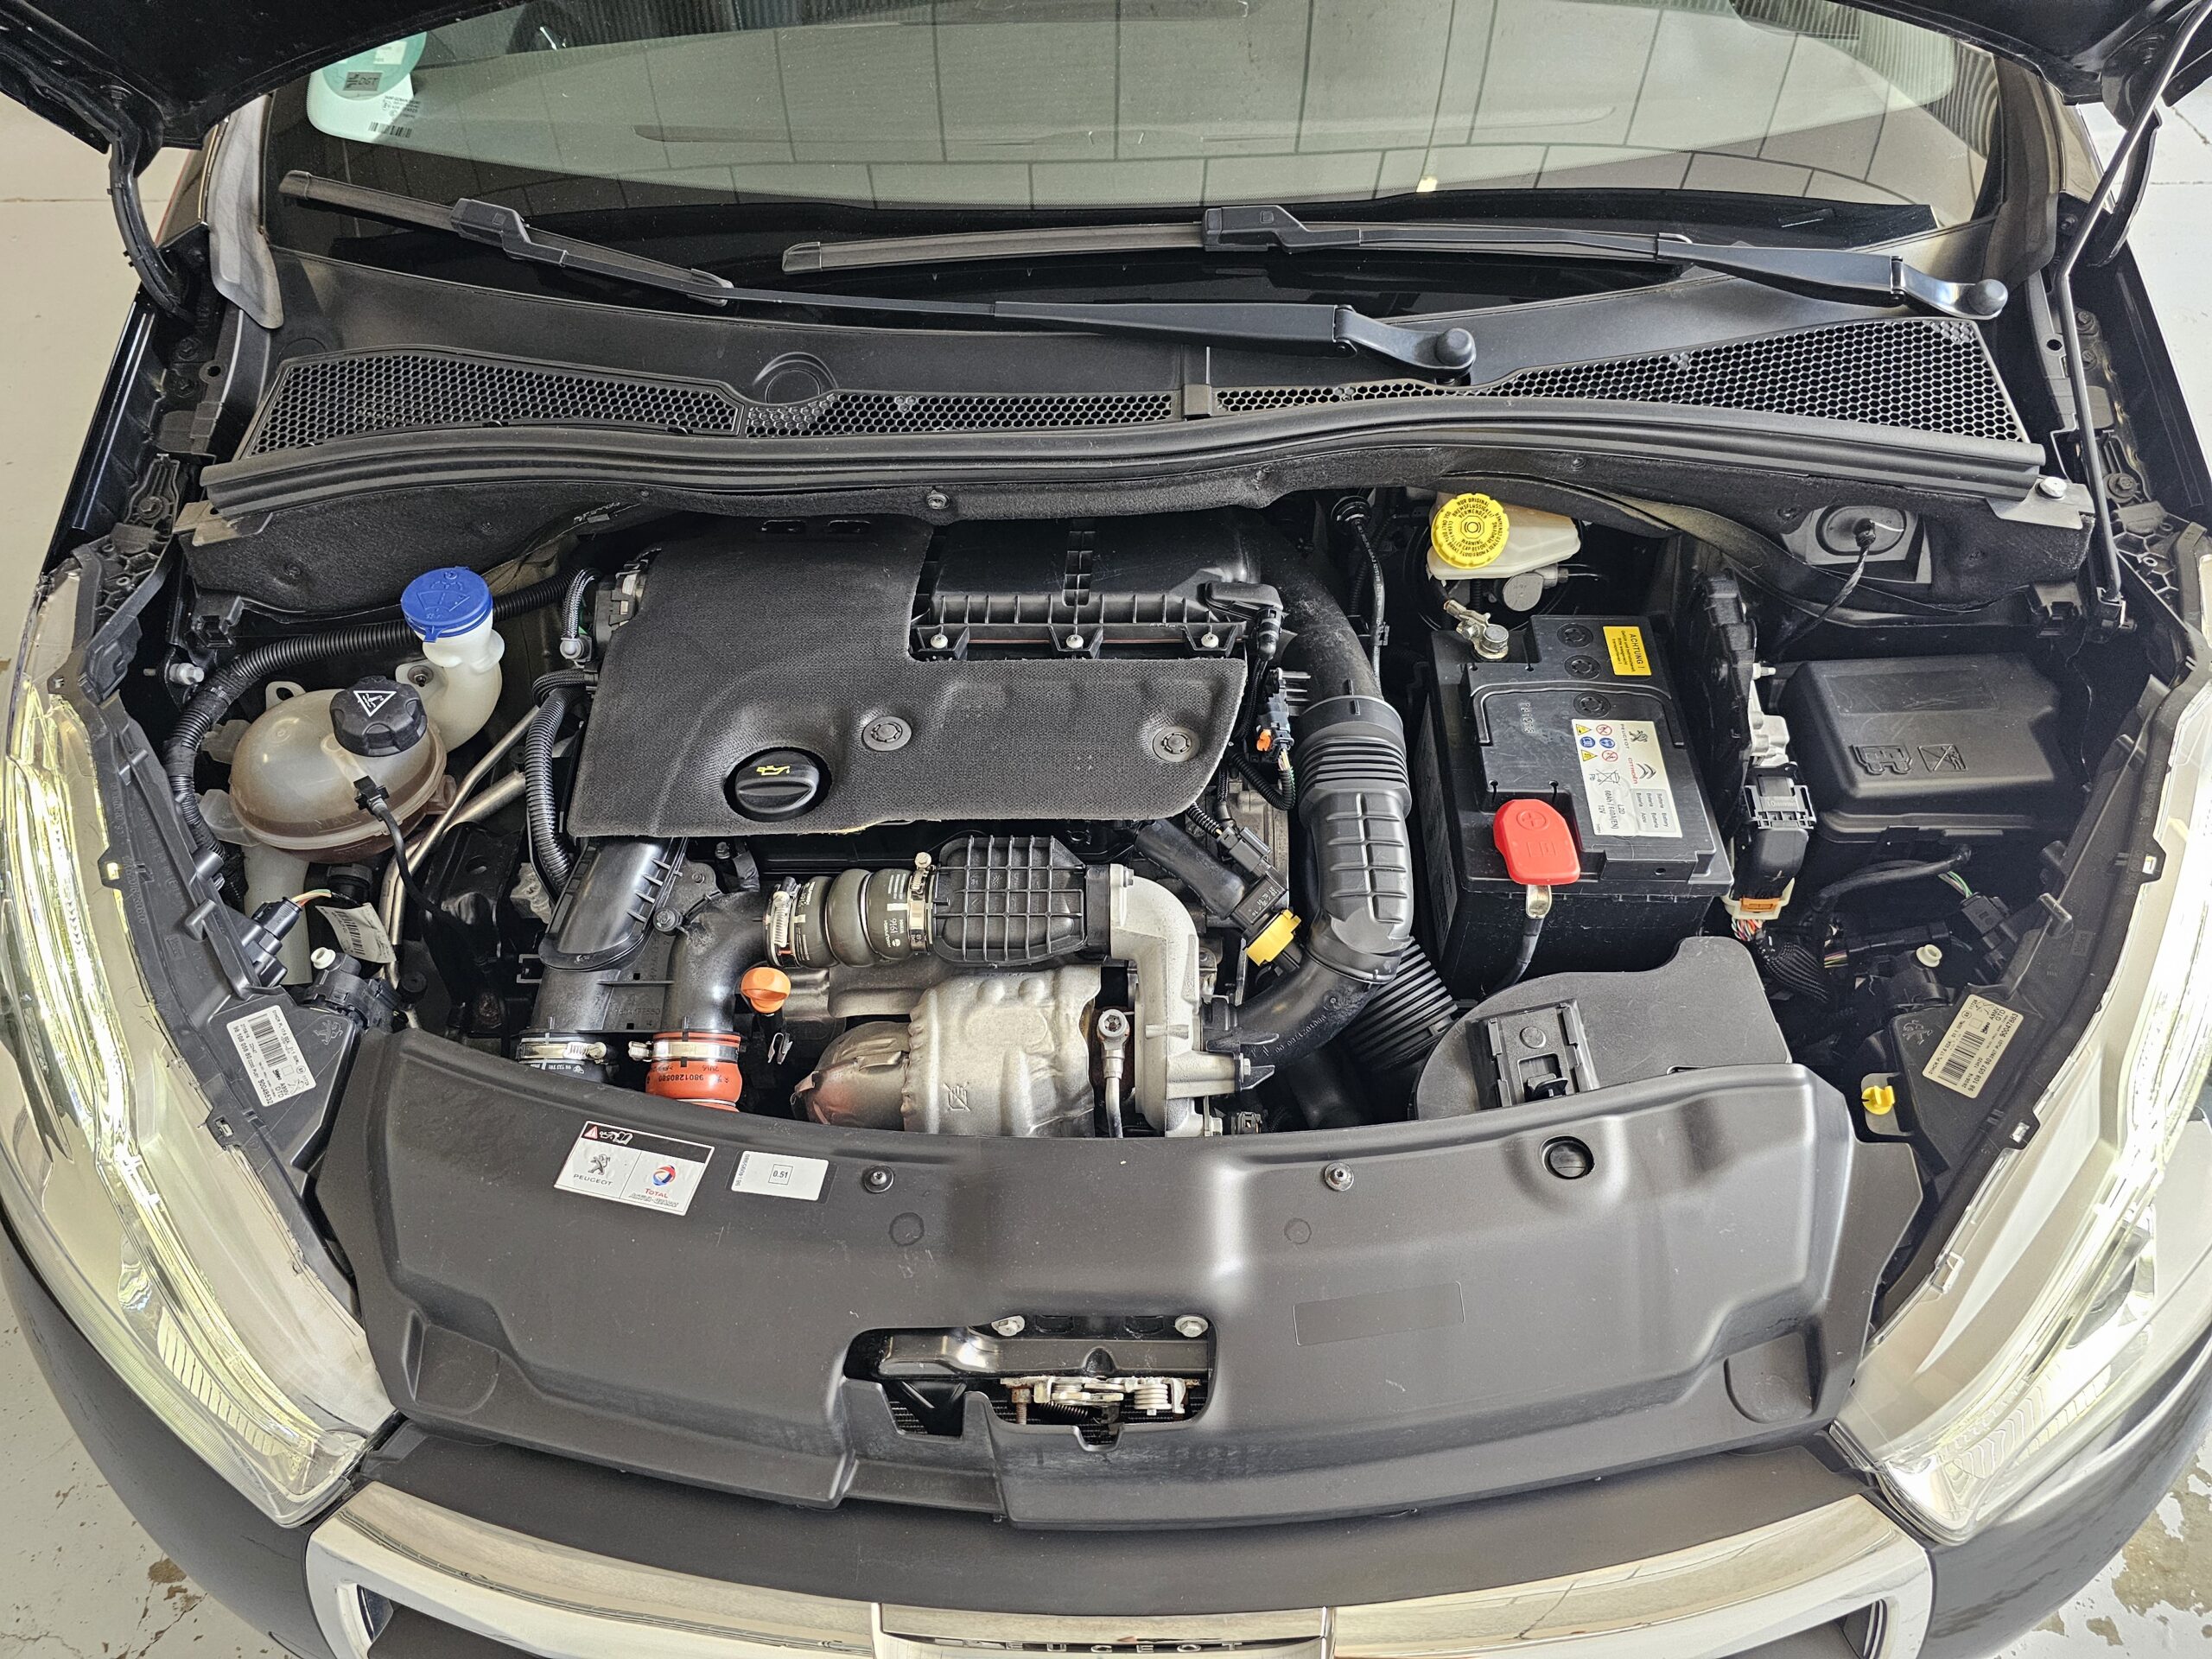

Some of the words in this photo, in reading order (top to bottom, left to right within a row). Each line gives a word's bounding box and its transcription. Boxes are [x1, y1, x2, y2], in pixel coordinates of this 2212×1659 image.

[1468, 498, 1490, 506] ORIGINAL
[1459, 509, 1487, 519] VERWENDEN
[1630, 632, 1643, 664] ACHTUNG
[1620, 724, 1630, 749] PEUGEOT
[1995, 1008, 2005, 1021] GTD
[1972, 1074, 1980, 1084] 108
[1978, 1065, 1986, 1075] 057
[573, 1172, 613, 1187] PEUGEOT
[773, 1170, 788, 1179] 0.51
[645, 1188, 669, 1198] TOTAL
